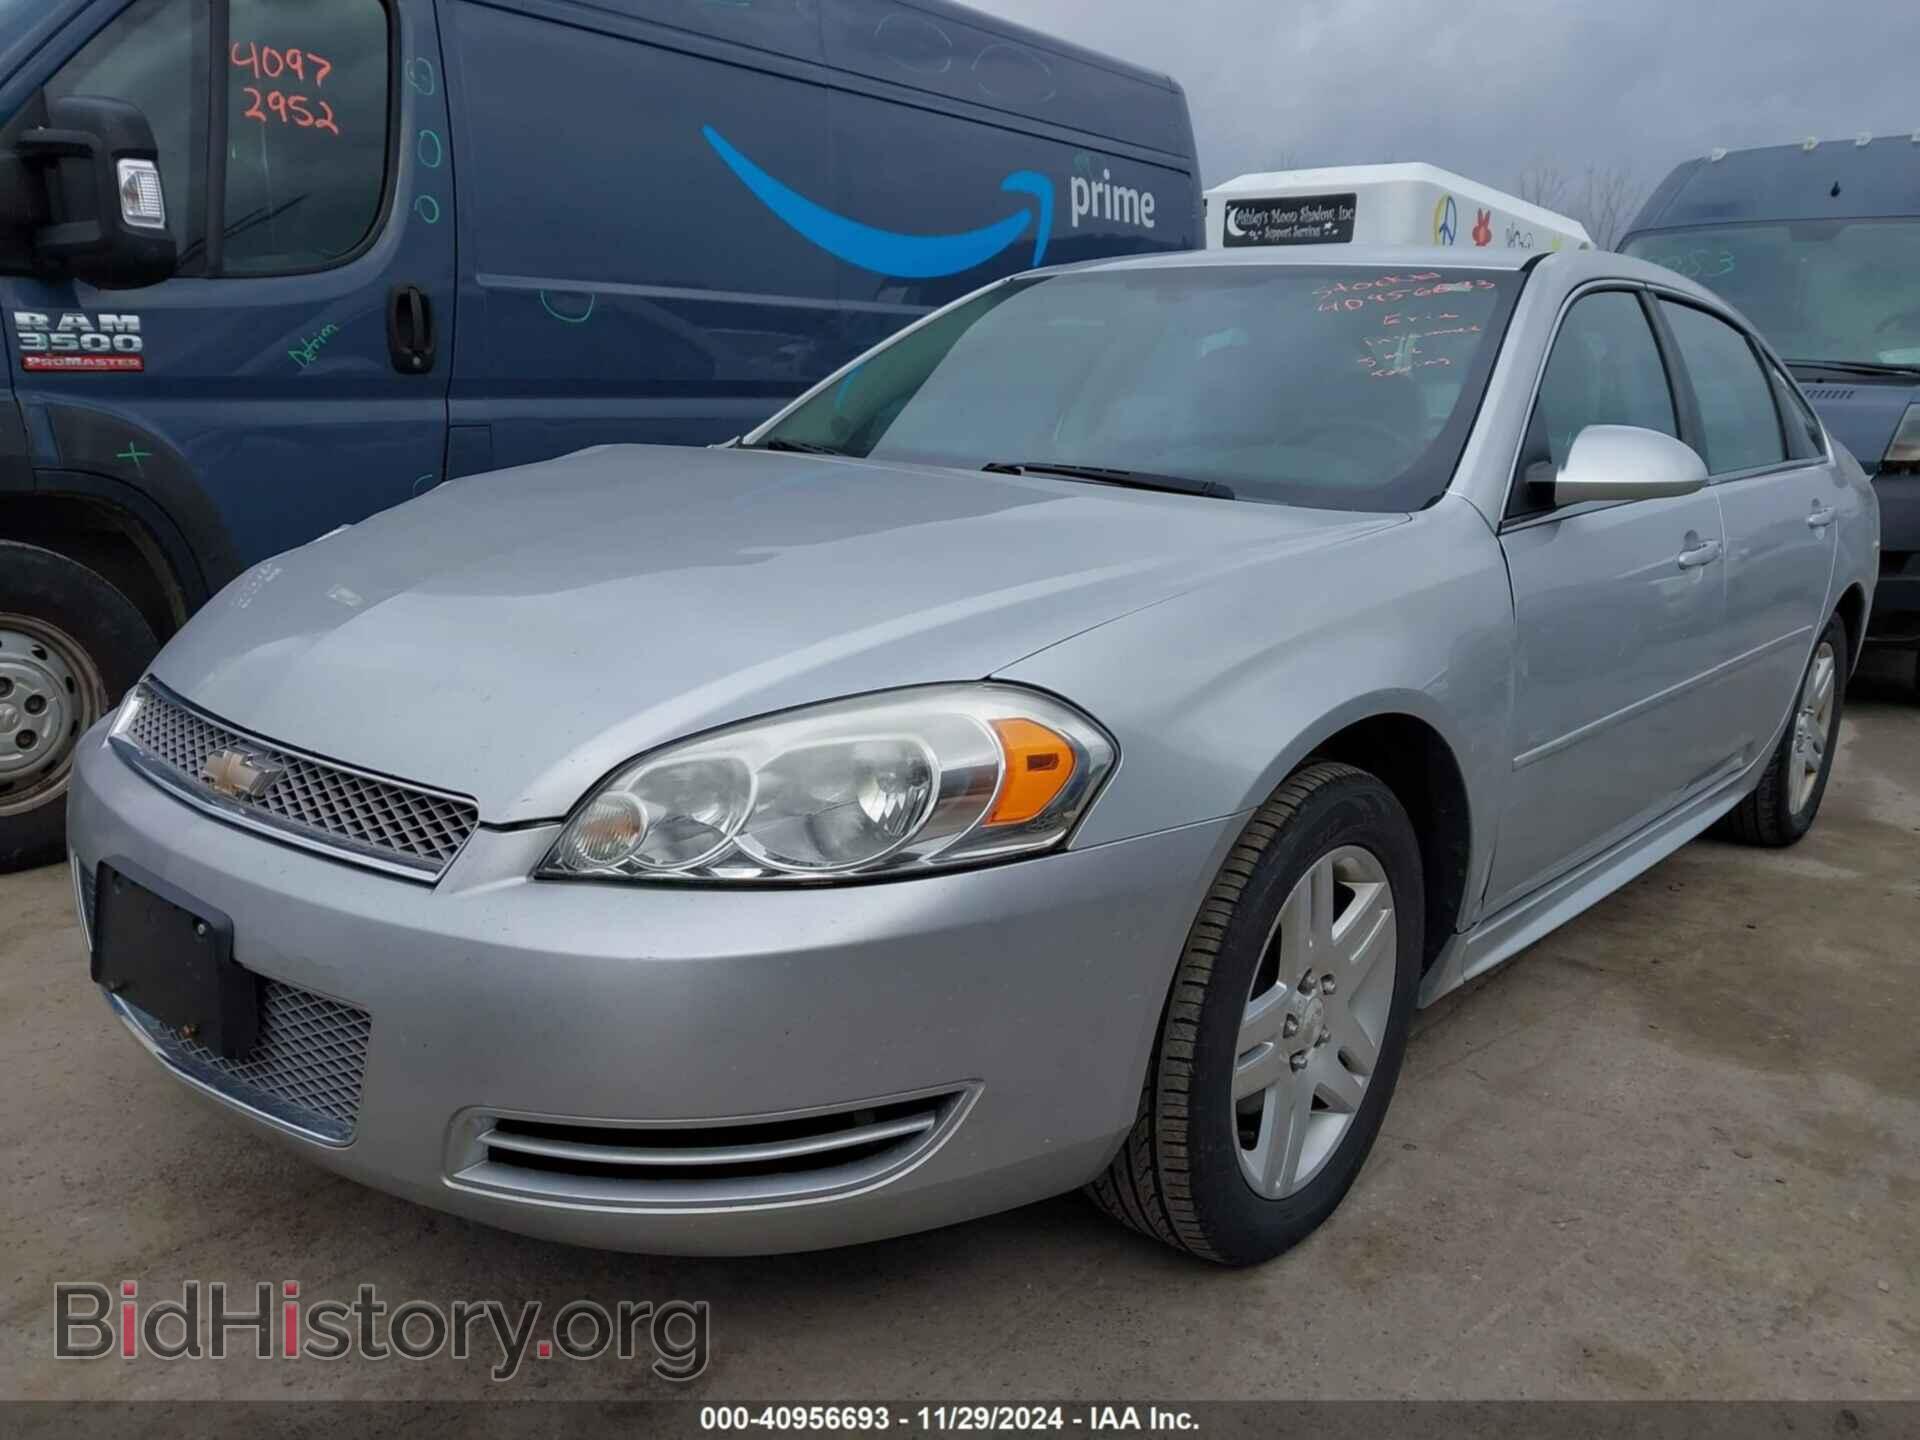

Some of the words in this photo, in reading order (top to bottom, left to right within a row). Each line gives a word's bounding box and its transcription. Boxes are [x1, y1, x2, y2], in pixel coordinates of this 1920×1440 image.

[231, 41, 332, 87] 4097
[243, 87, 339, 135] 2952
[1070, 167, 1156, 228] prime
[14, 311, 140, 332] RAM
[18, 332, 143, 352] 3500
